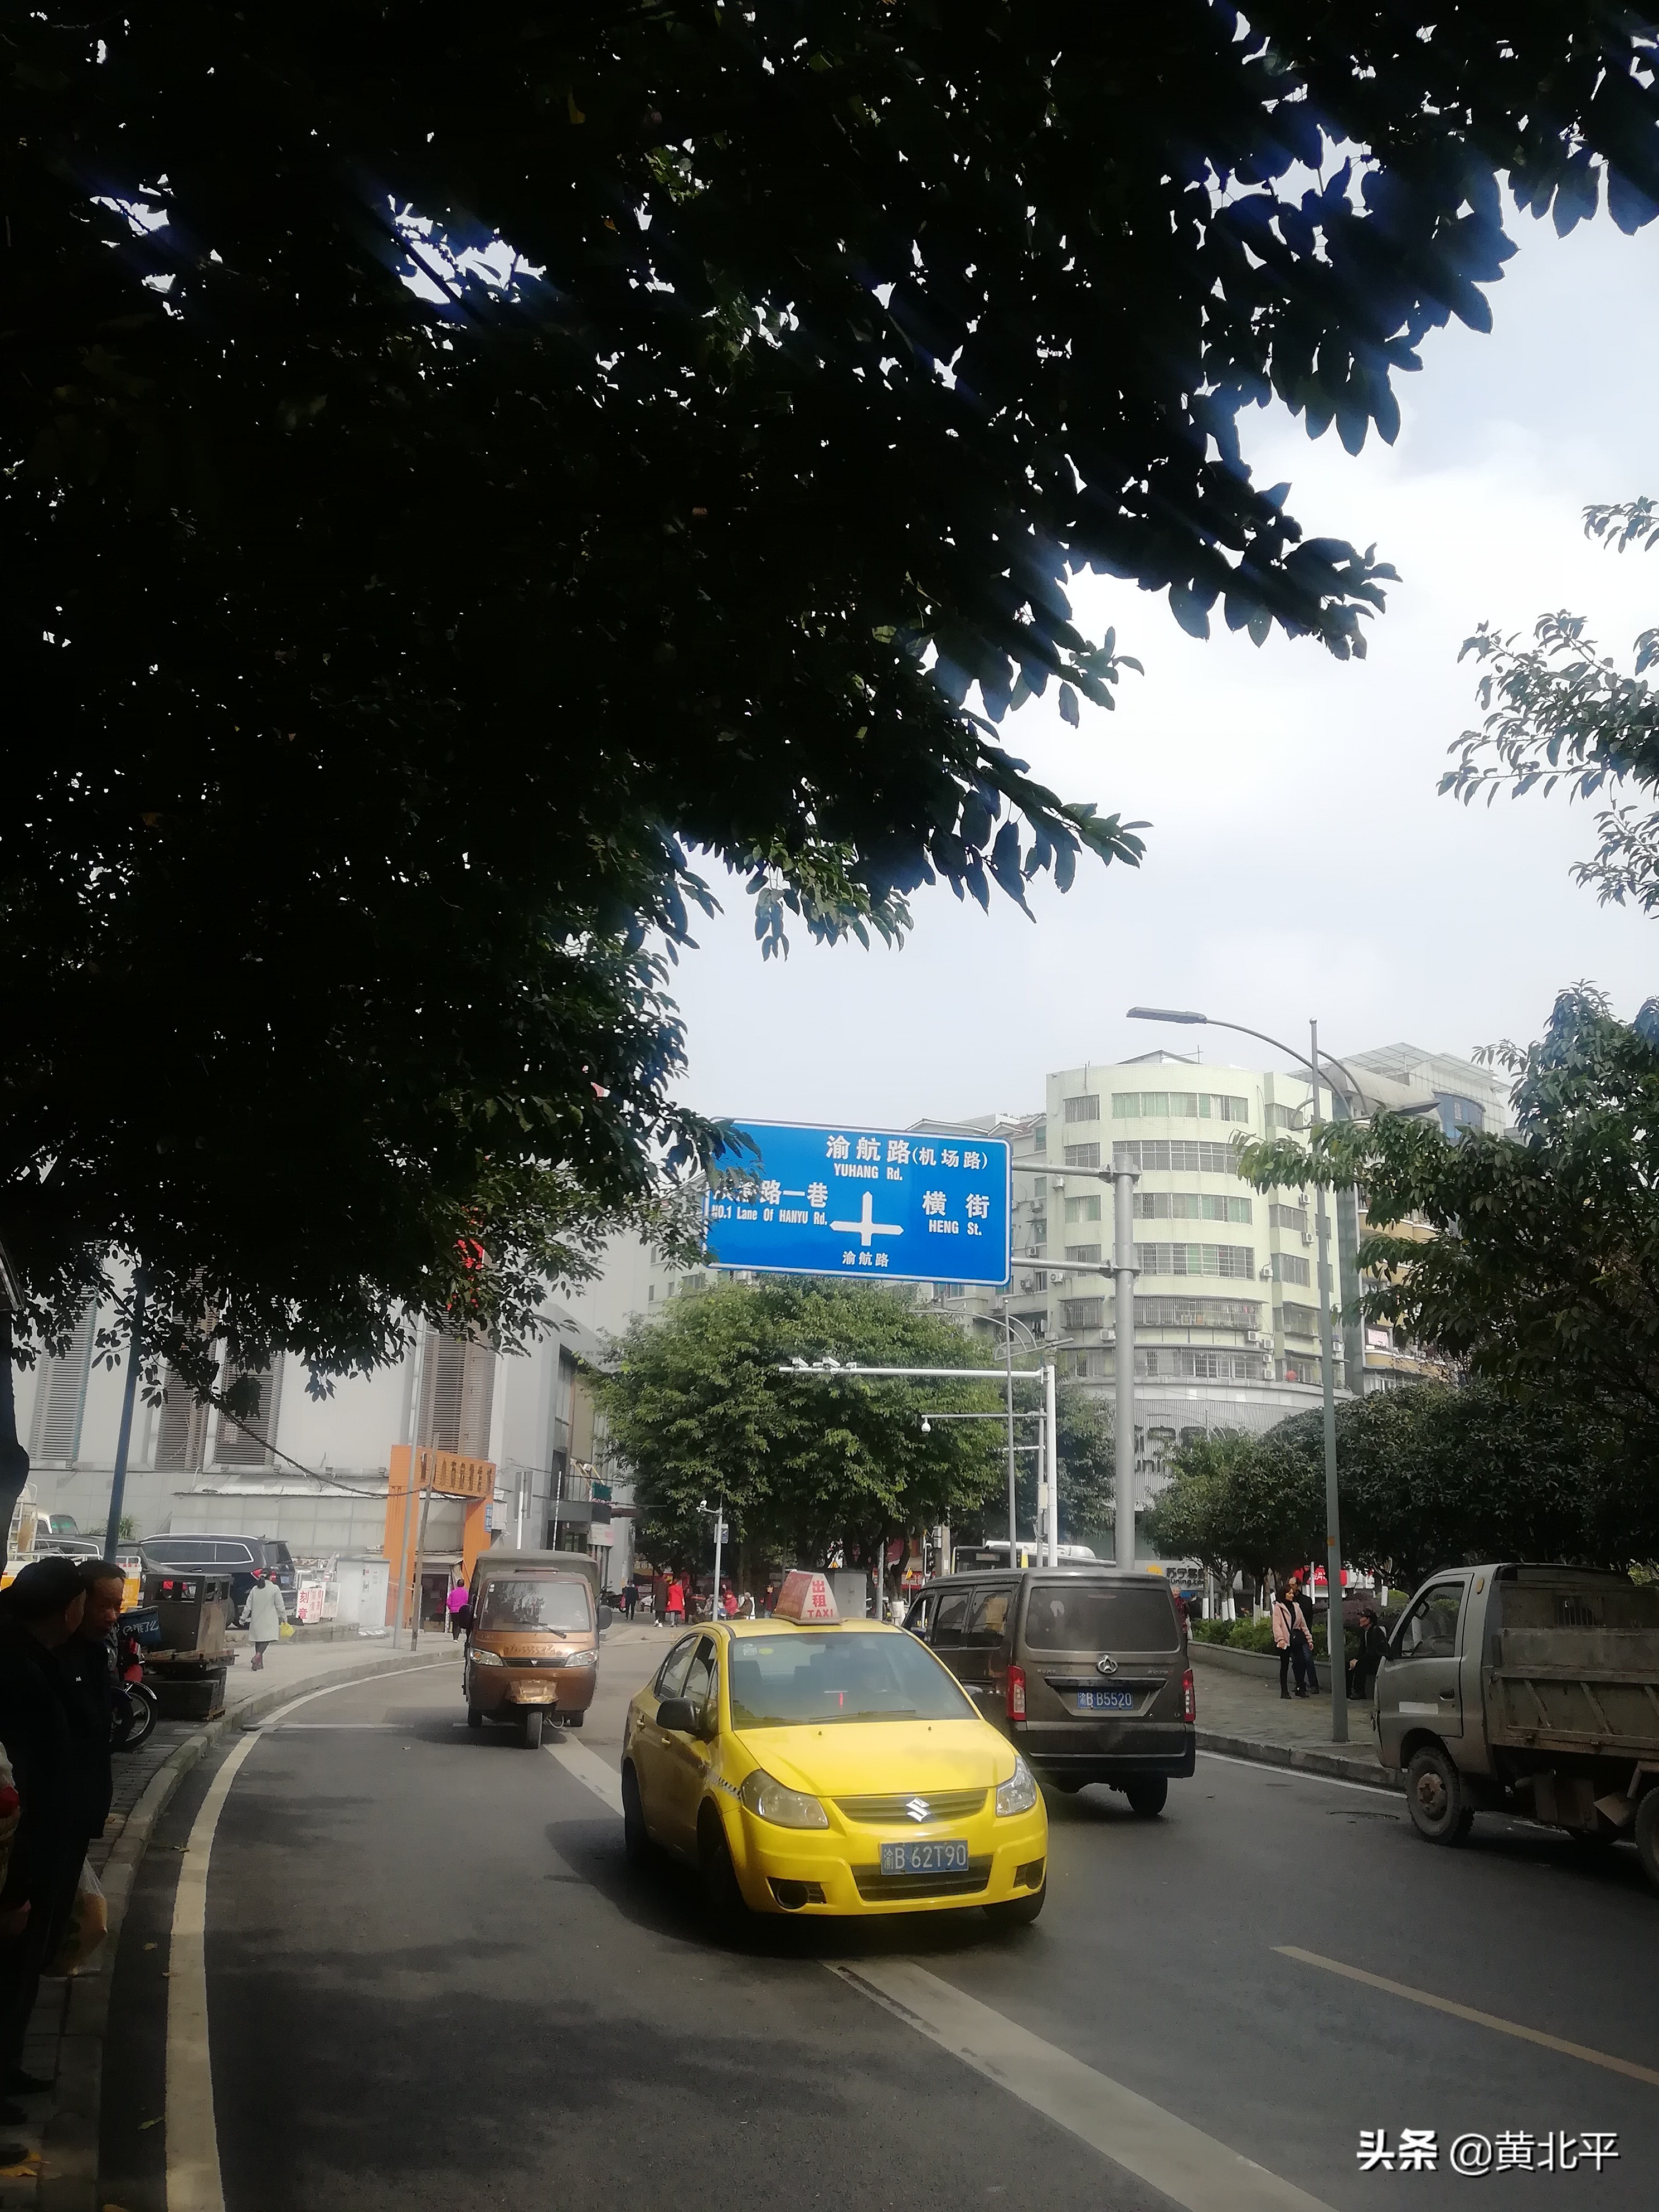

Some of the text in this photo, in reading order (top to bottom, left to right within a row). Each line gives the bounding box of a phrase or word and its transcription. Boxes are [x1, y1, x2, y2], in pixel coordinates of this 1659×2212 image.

[833, 1162, 903, 1181] YUHANG Rd.
[923, 1190, 990, 1219] 横街
[711, 1204, 828, 1226] NO.1 Lane Of HANYU Rd.
[928, 1219, 983, 1236] HENG St.
[842, 1250, 890, 1268] 渝航路
[812, 1580, 827, 1608] 出租
[298, 1590, 310, 1620] 刻章
[807, 1608, 834, 1618] TAXI
